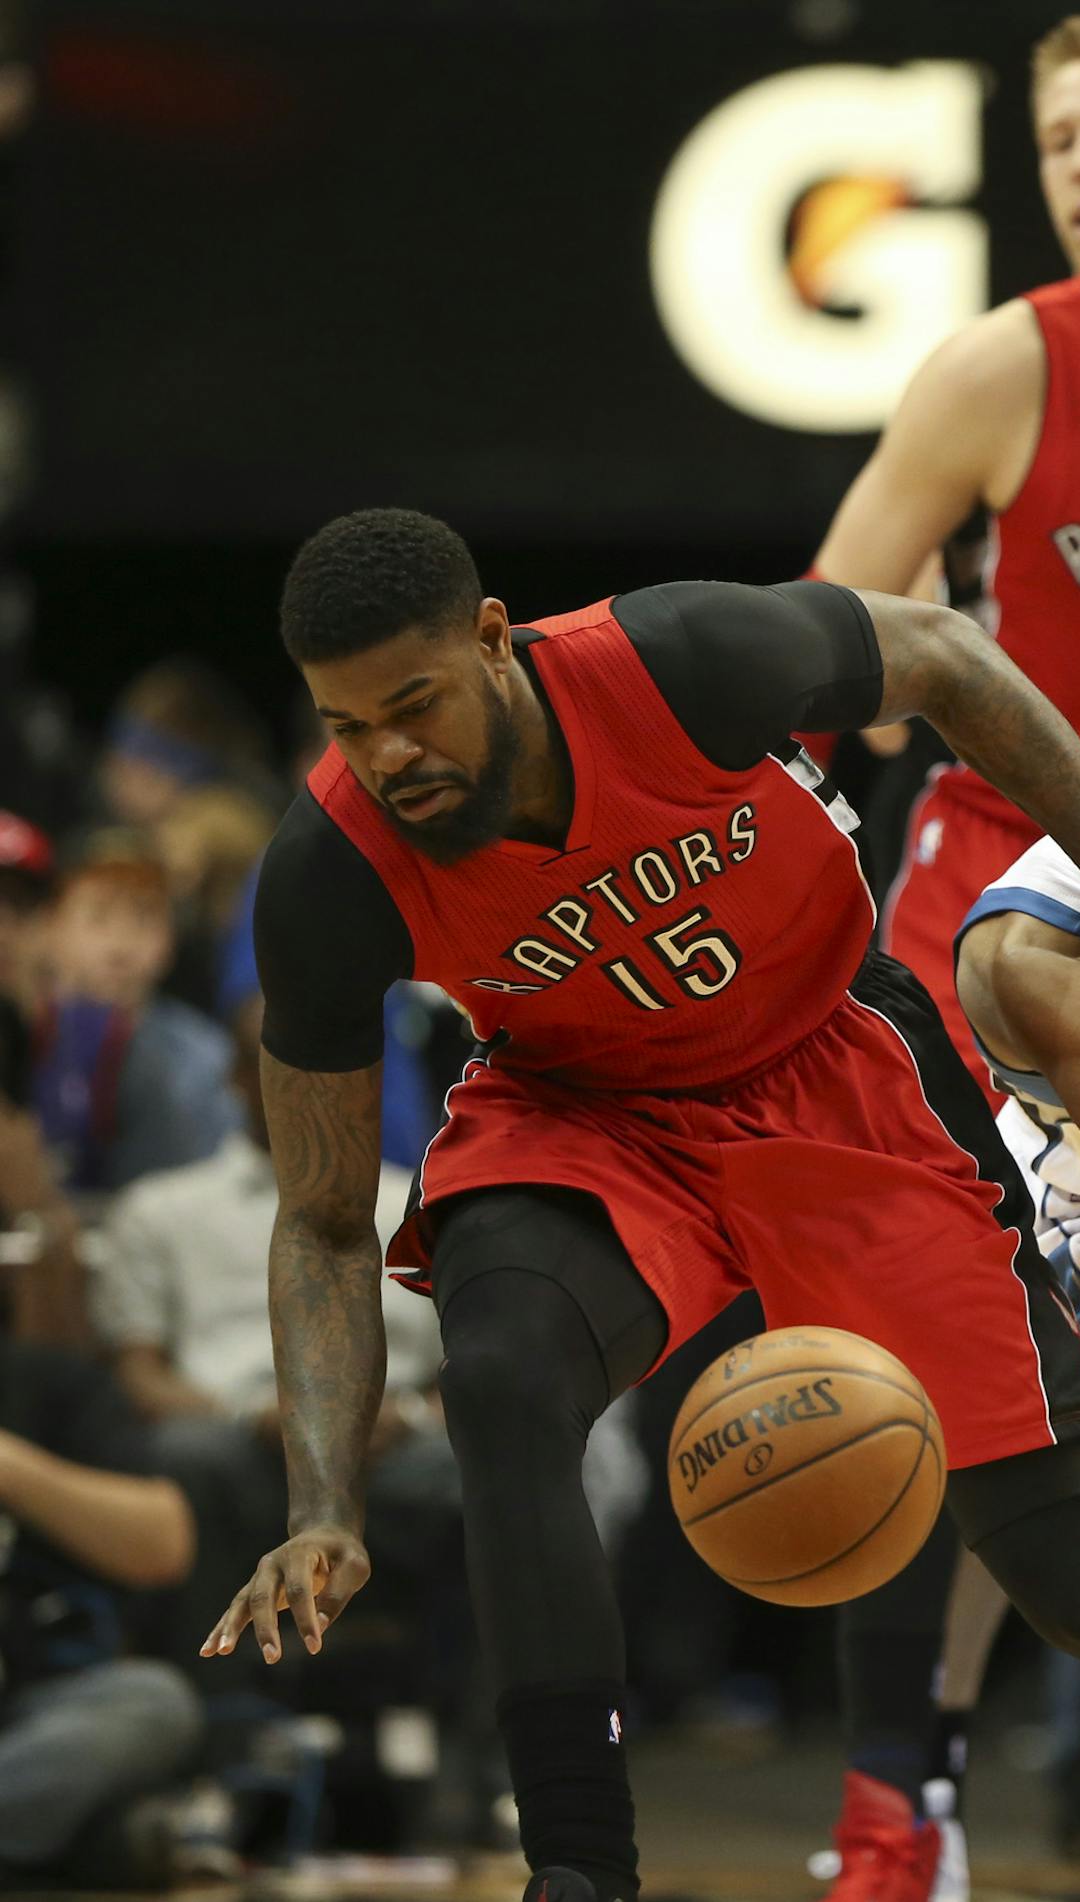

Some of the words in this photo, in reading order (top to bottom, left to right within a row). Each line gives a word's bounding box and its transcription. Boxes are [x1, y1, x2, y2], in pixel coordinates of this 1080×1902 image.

[650, 58, 990, 434] G
[469, 804, 758, 997] RAPTORS
[604, 907, 742, 1011] 15
[678, 1377, 842, 1494] SPALDING
